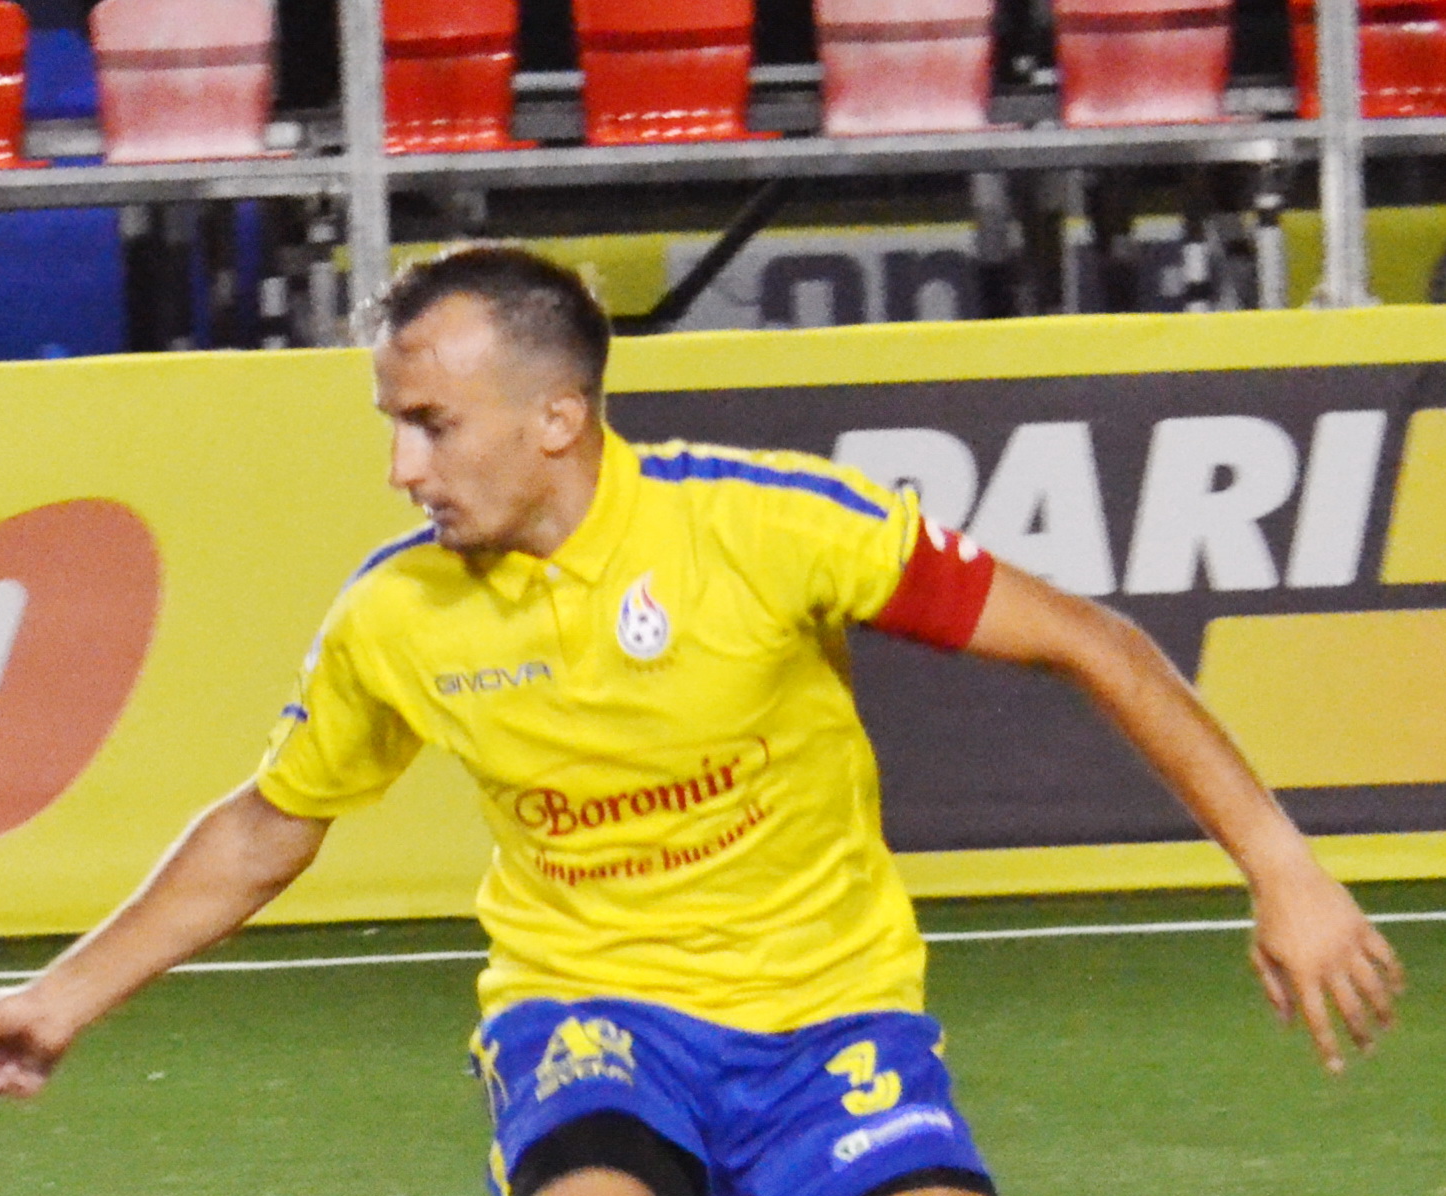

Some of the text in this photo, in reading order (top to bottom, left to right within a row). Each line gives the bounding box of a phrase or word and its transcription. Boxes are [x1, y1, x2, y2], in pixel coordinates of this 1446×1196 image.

[832, 405, 1389, 598] PARI
[434, 659, 553, 695] GIVOVA
[514, 755, 741, 837] Boromir
[823, 1039, 903, 1117] 3
